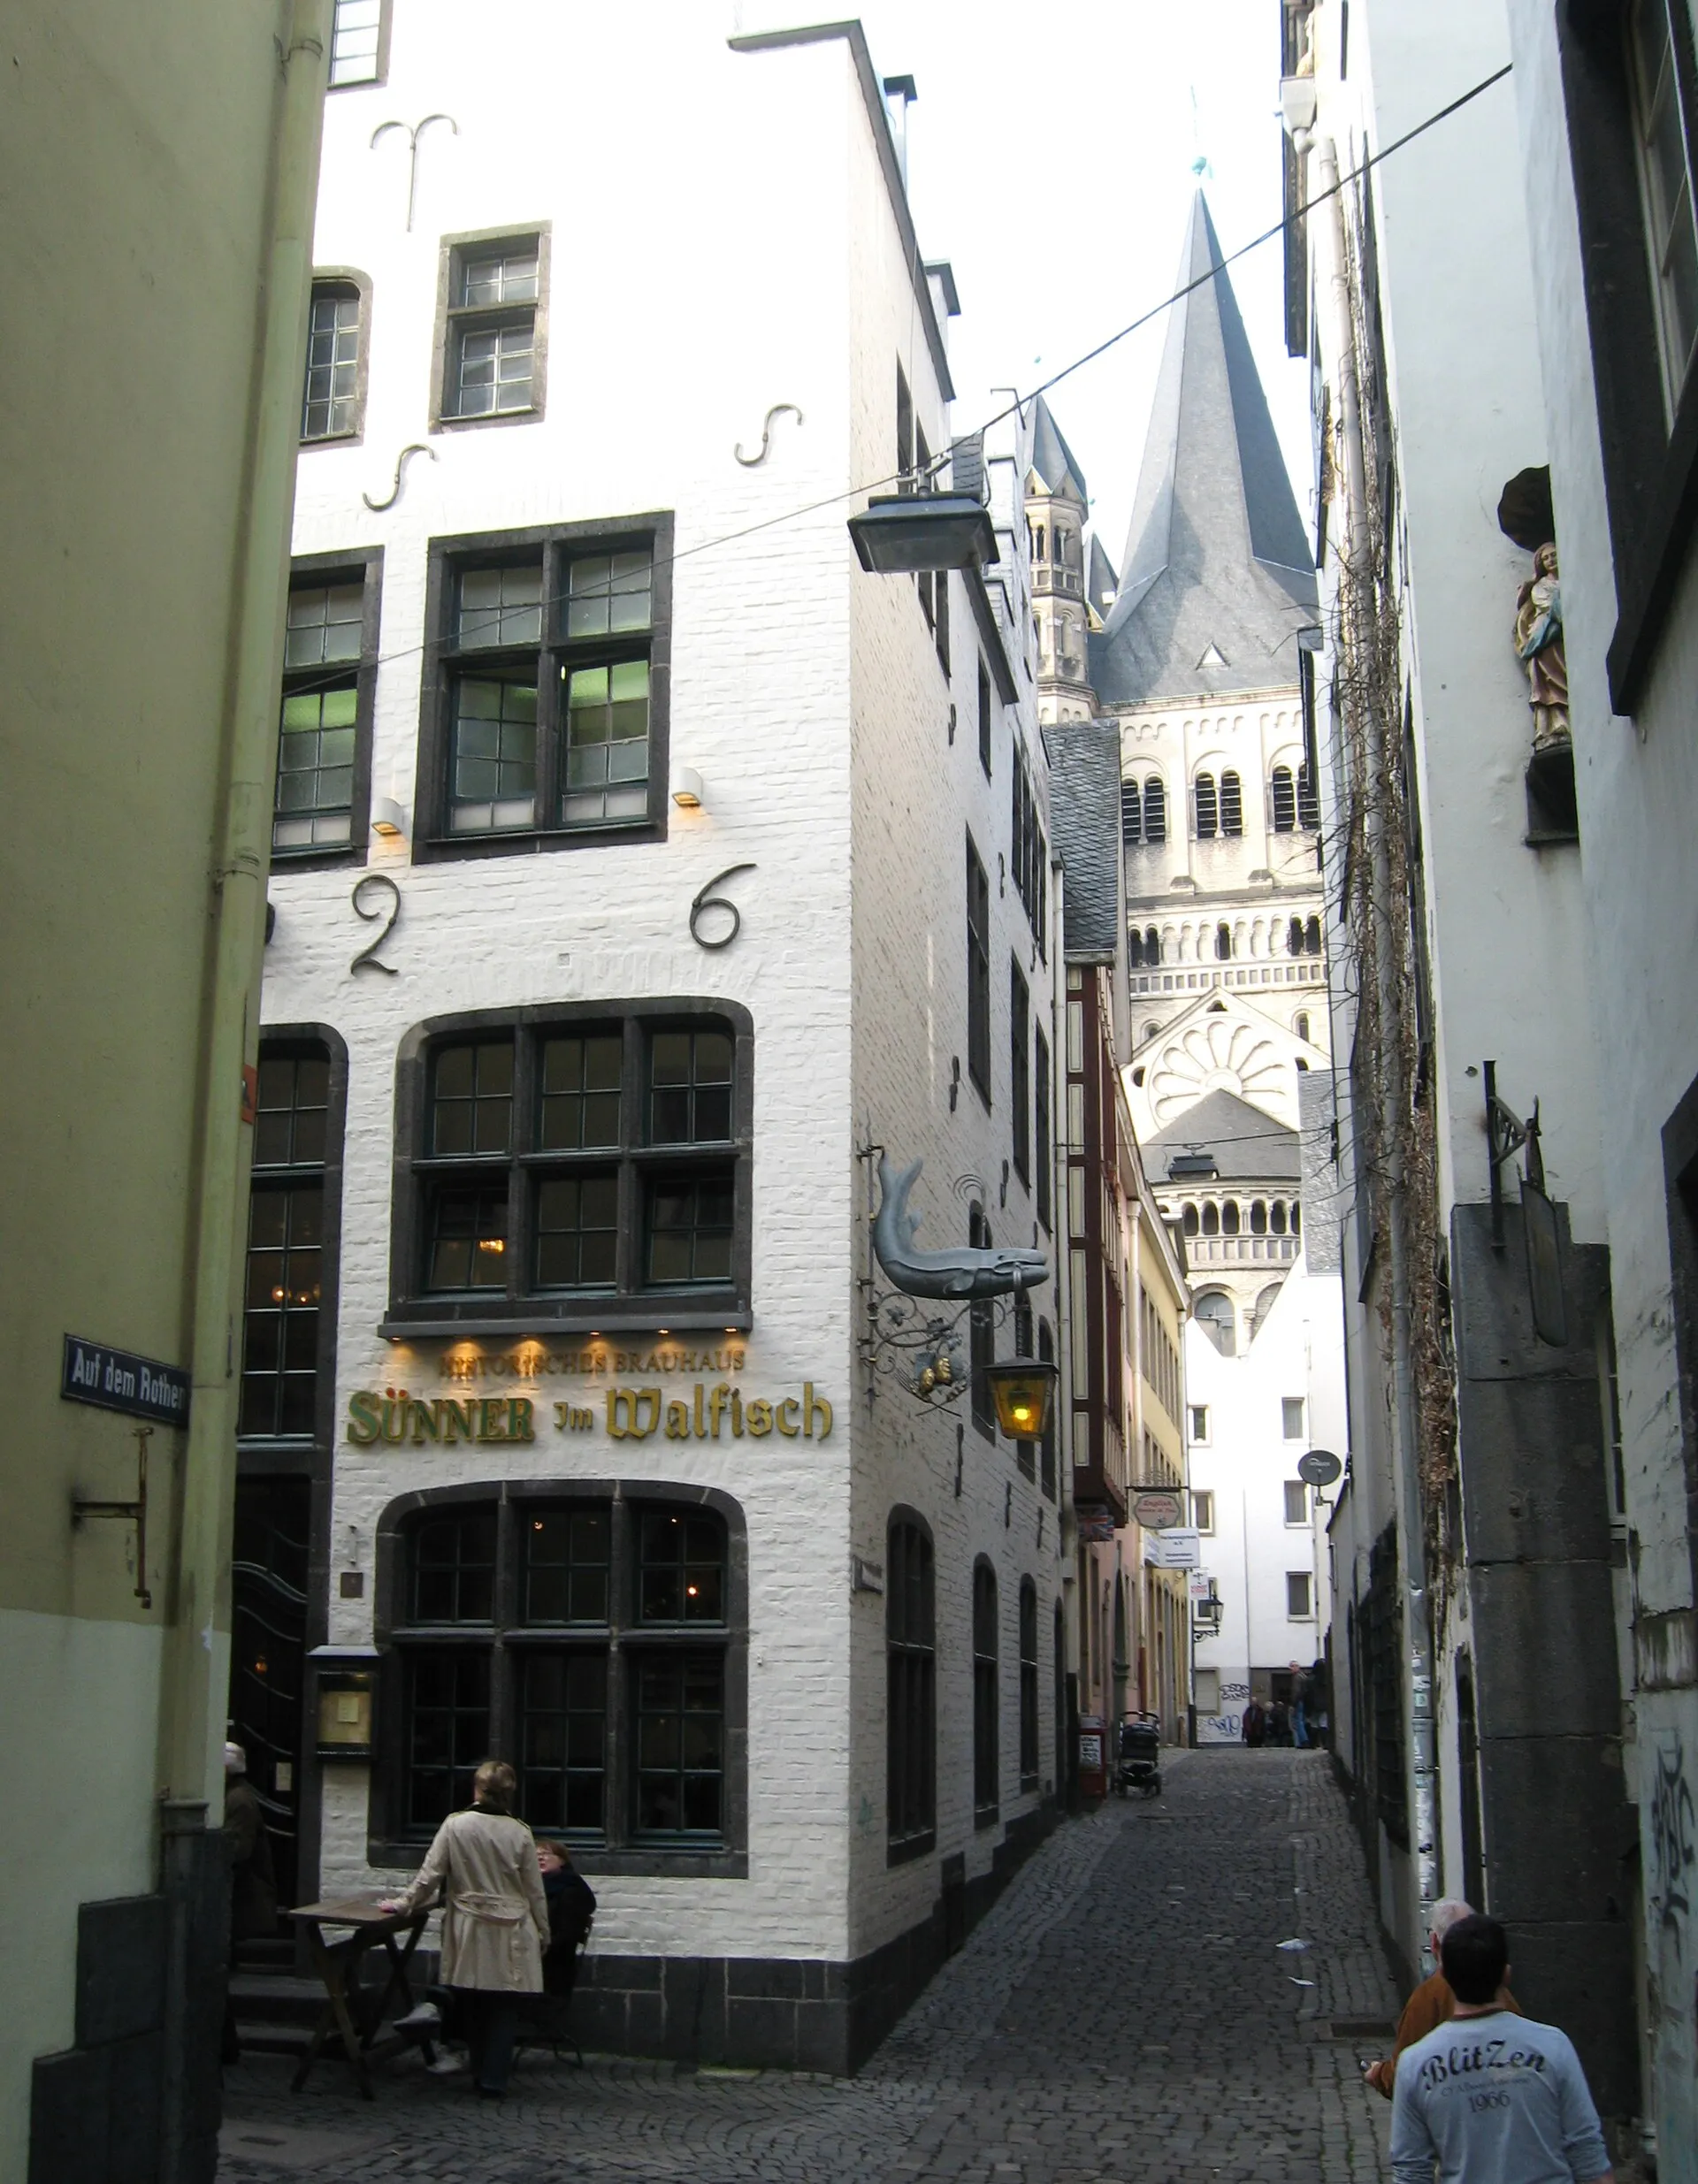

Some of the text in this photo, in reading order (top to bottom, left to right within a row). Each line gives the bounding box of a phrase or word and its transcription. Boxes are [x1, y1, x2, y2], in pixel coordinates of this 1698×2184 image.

[71, 1347, 102, 1389] Auf
[105, 1356, 135, 1399] dem
[613, 1348, 745, 1373] BRAUHAUS
[347, 1387, 535, 1444] SÜNNER
[606, 1381, 833, 1441] Walfisch
[1468, 2089, 1511, 2113] 1966
